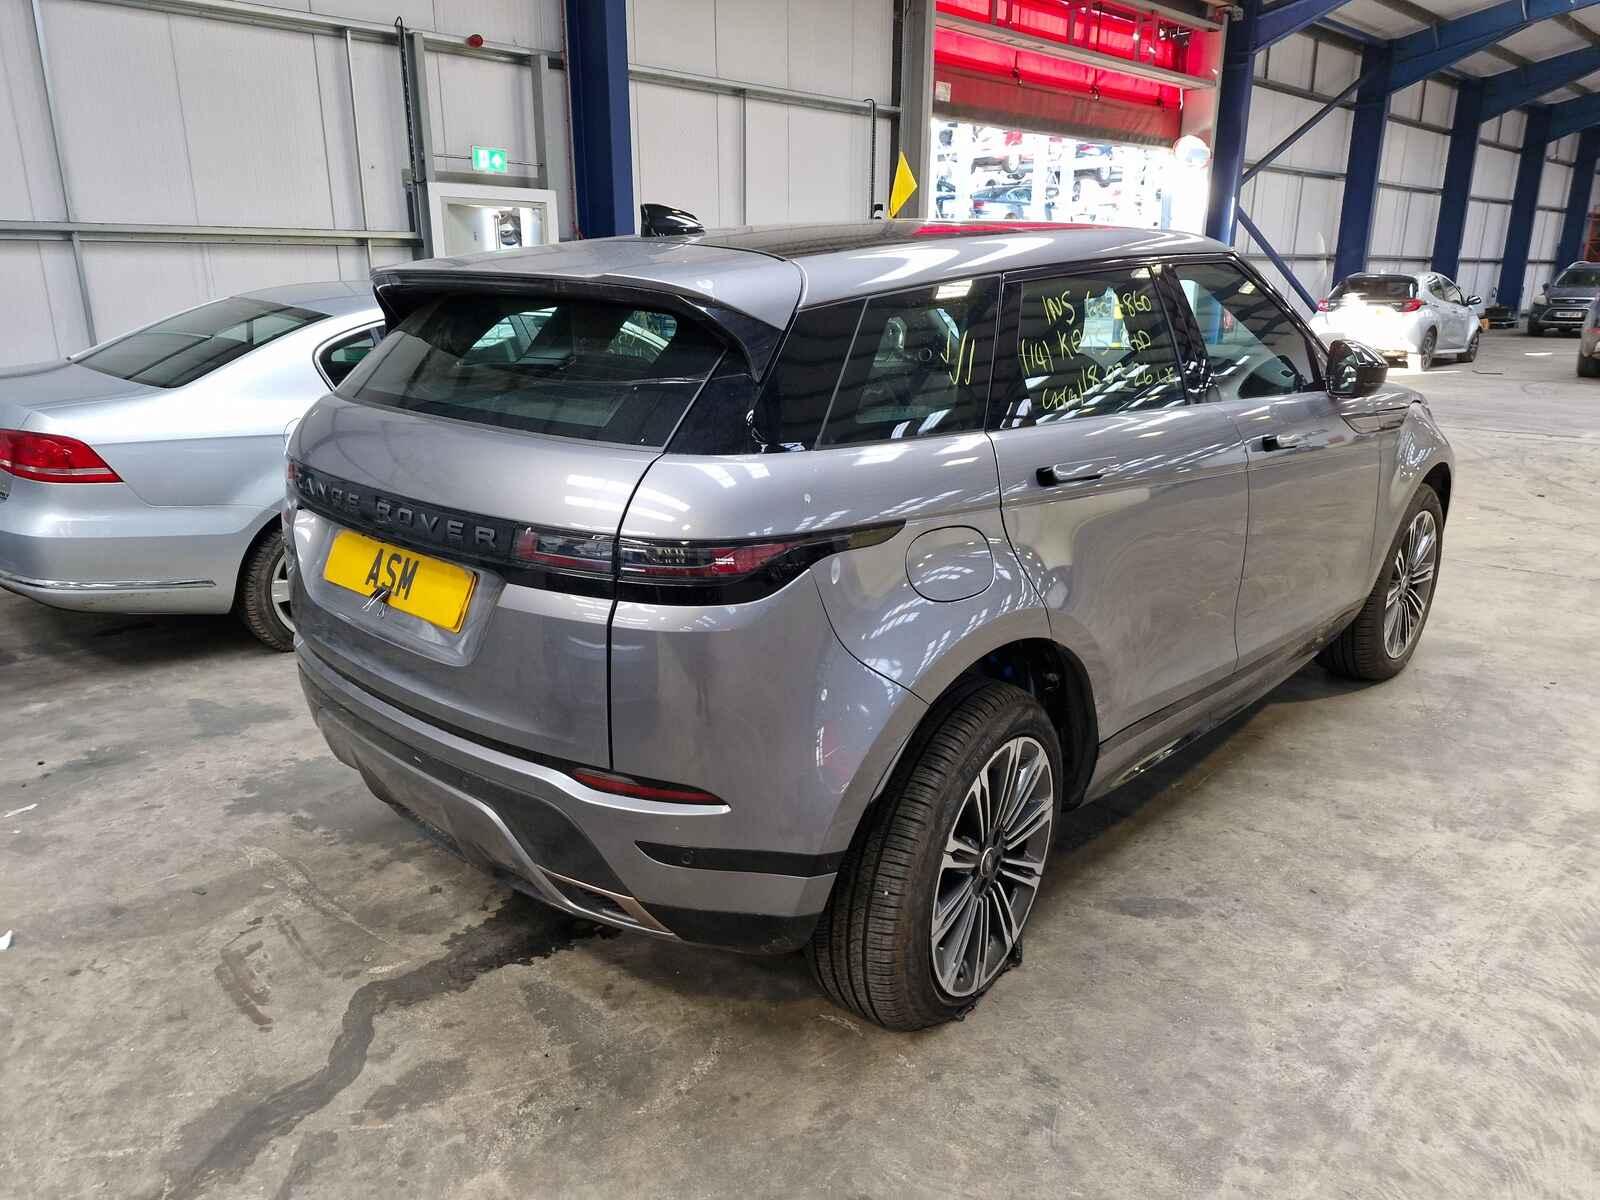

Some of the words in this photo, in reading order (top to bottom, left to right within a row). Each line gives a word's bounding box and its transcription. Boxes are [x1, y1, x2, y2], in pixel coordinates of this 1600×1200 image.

[1042, 290, 1076, 325] INS
[294, 471, 361, 513] RANGE
[376, 501, 497, 548] ROVER
[365, 547, 420, 601] ASM
